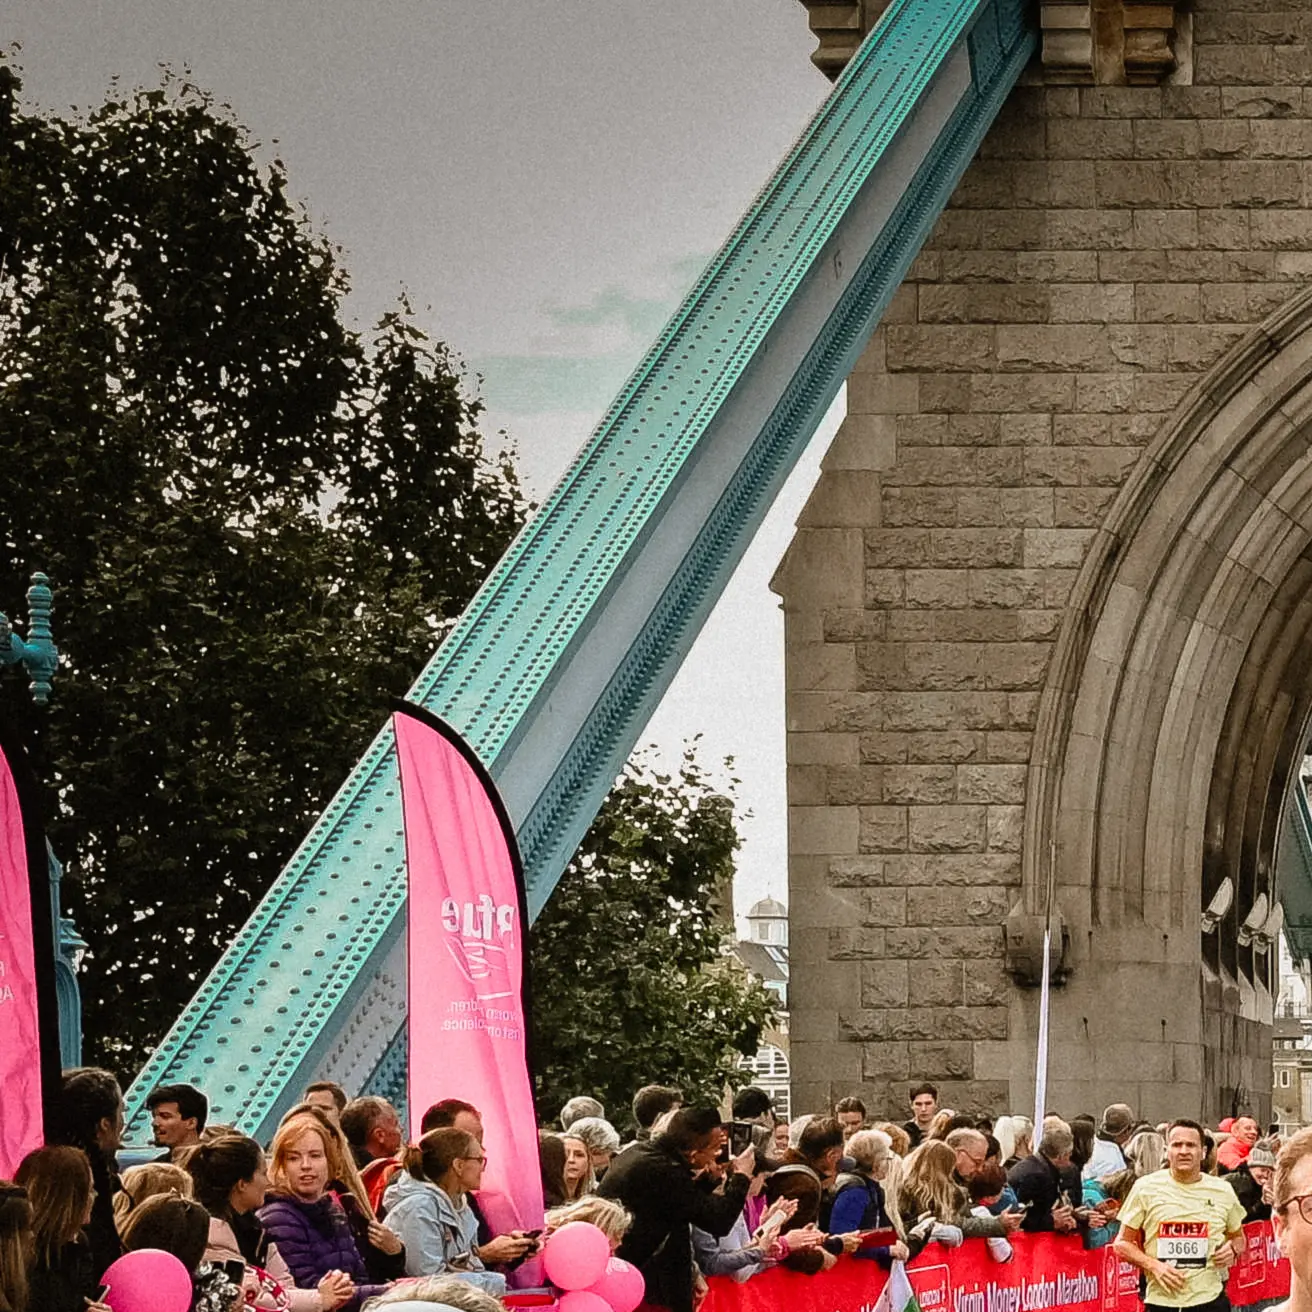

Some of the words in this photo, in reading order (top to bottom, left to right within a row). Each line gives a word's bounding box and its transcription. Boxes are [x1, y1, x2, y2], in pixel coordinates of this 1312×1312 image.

[1168, 1241, 1199, 1255] 3666
[1021, 1274, 1055, 1309] London
[1056, 1273, 1098, 1304] Marathon
